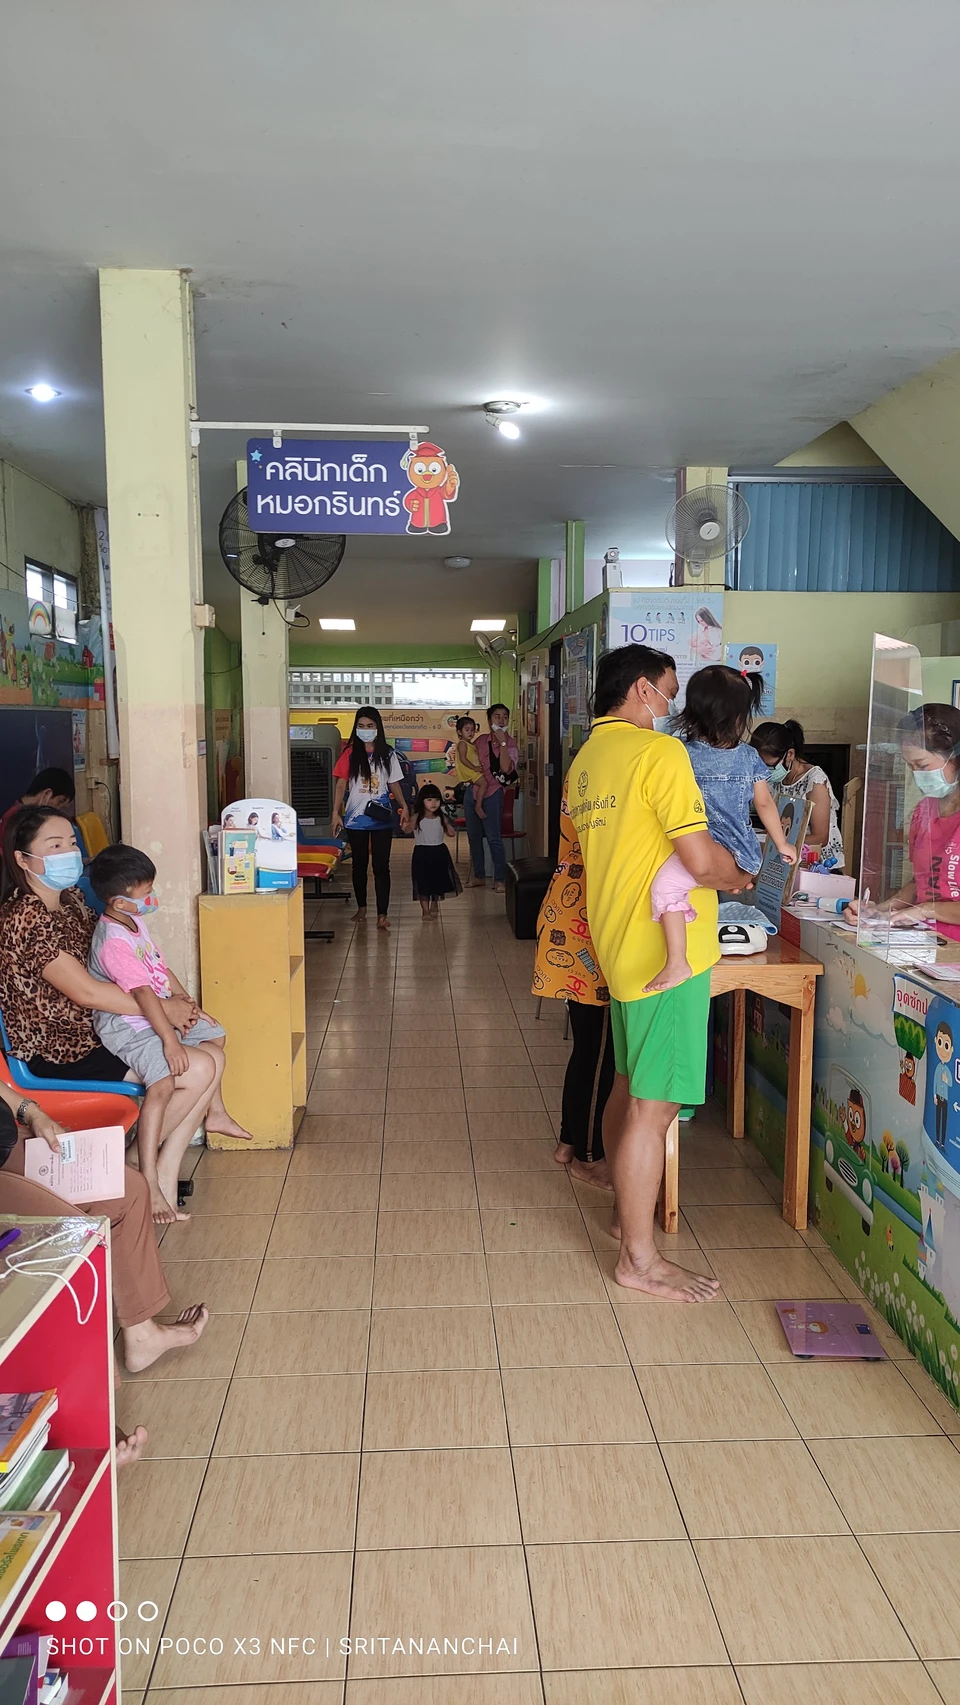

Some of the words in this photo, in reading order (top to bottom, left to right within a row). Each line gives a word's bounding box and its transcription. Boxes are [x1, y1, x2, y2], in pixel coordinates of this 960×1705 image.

[266, 453, 388, 482] คลินิกเด็ก
[256, 490, 401, 517] หมอกรินทร์
[620, 624, 647, 643] 10
[648, 628, 675, 642] TIPS
[610, 795, 617, 808] 2
[947, 854, 960, 880] Slow
